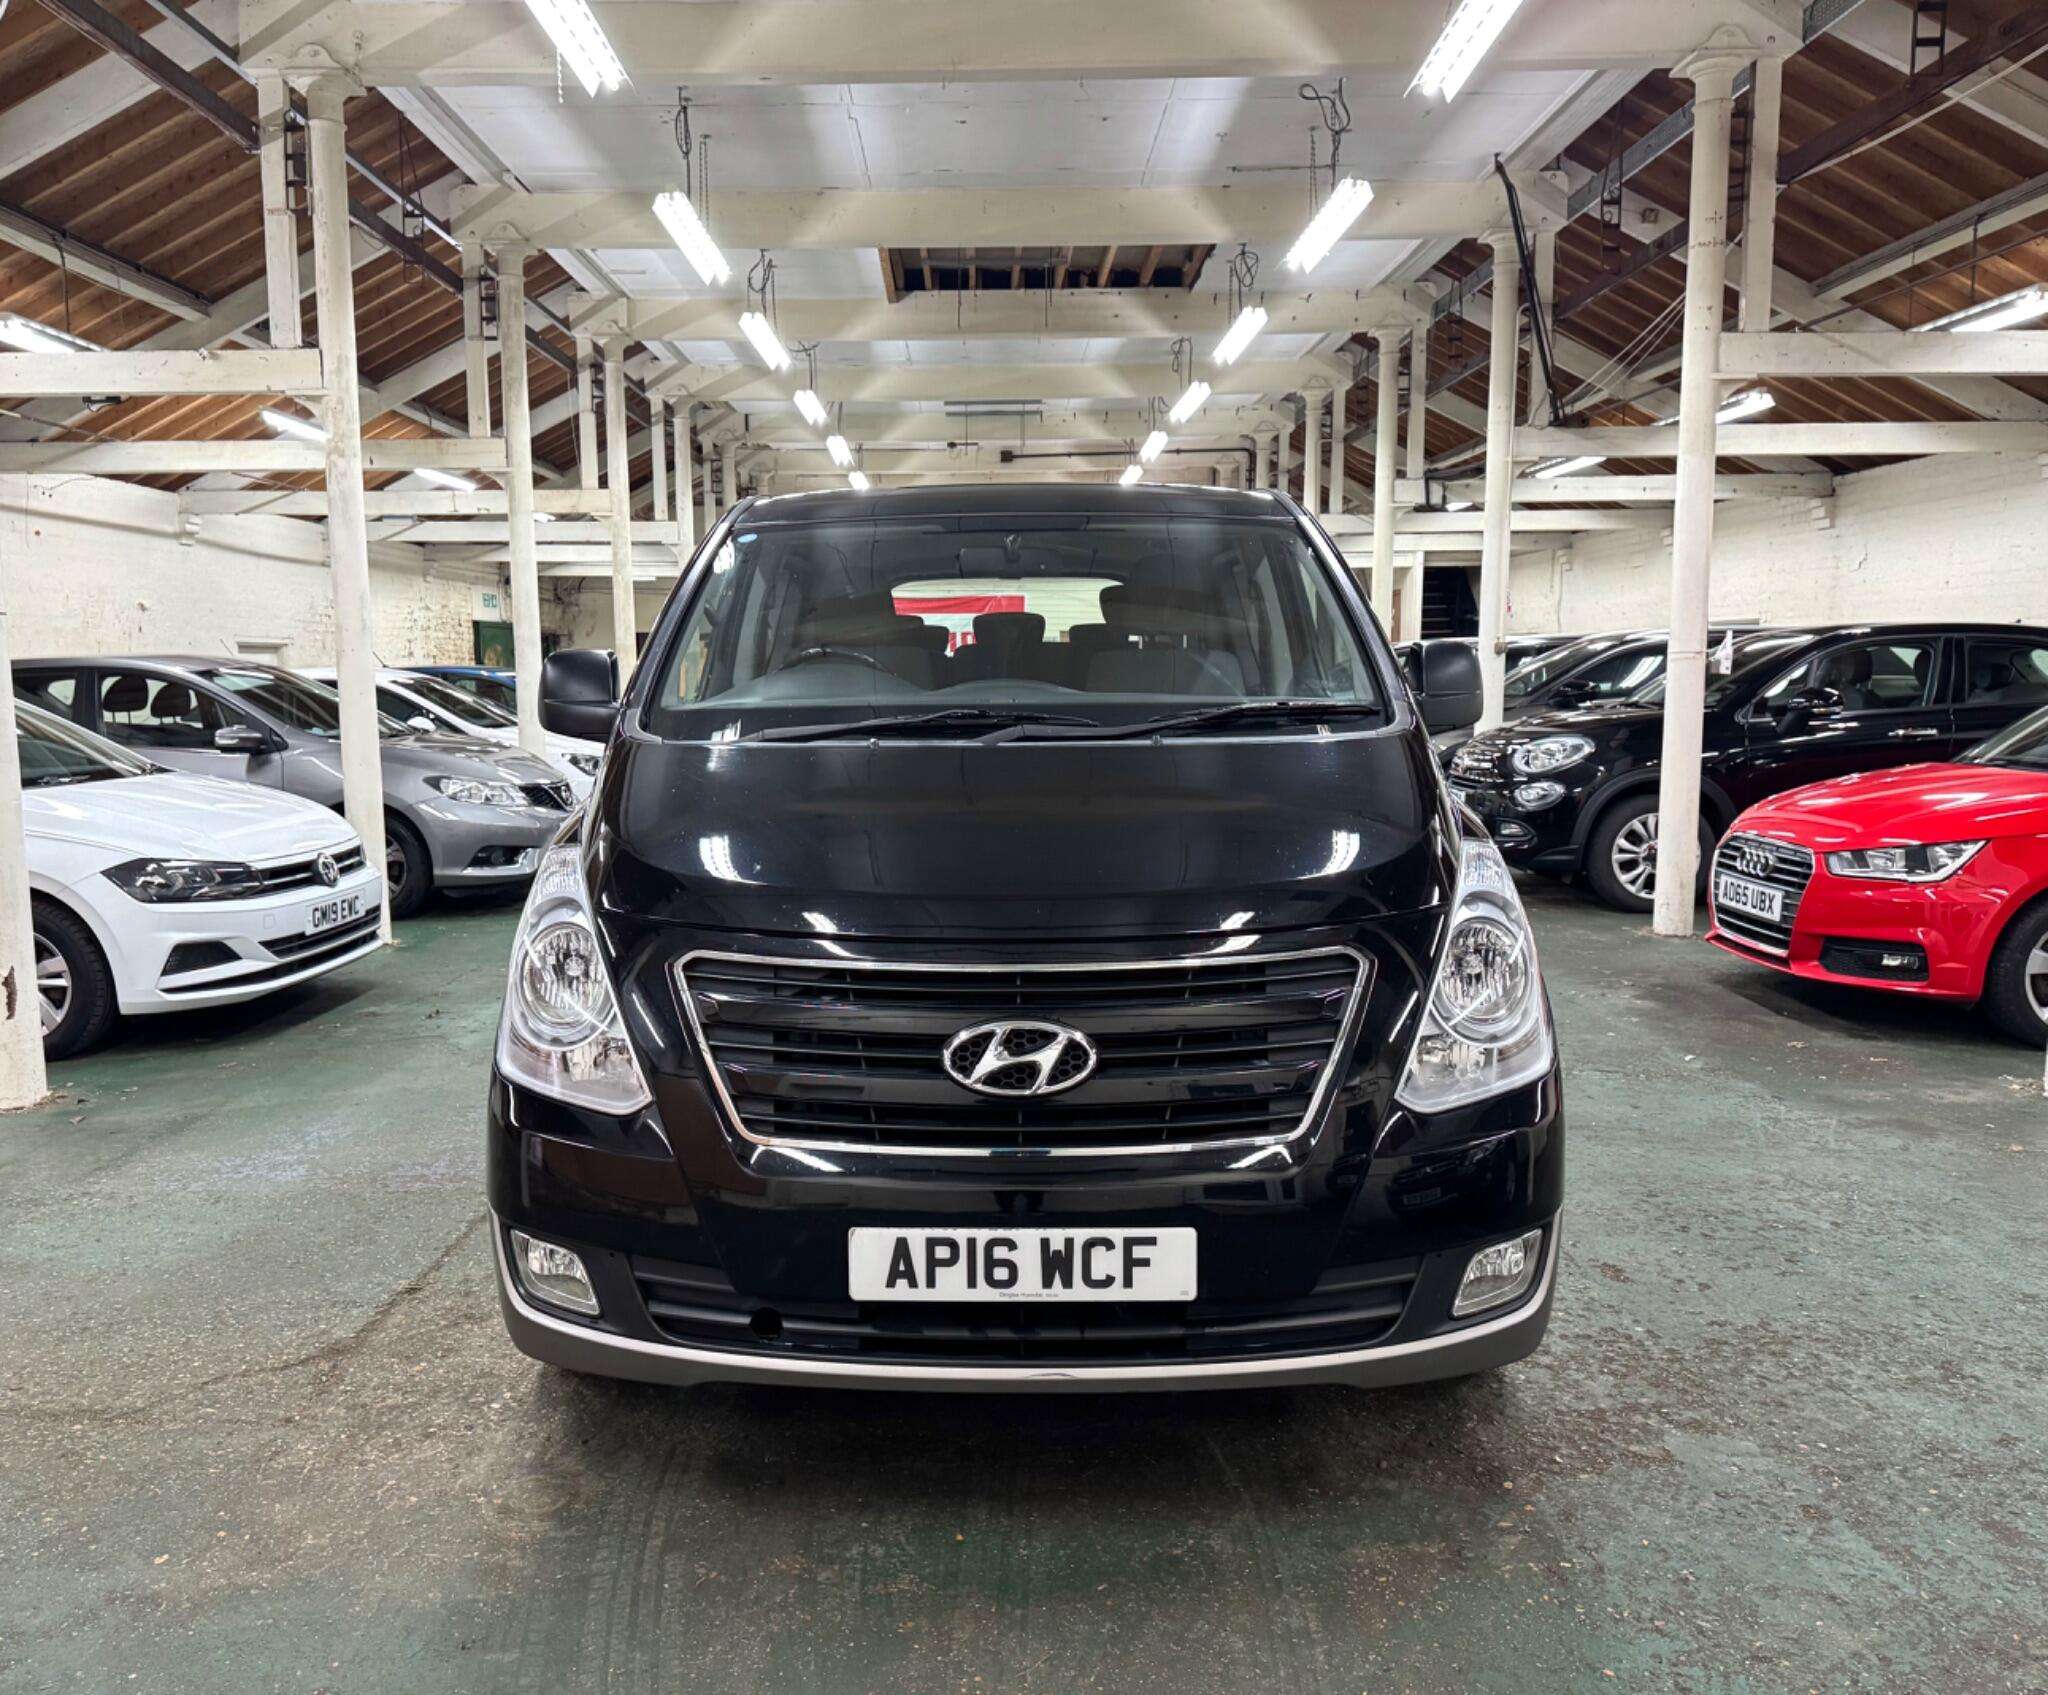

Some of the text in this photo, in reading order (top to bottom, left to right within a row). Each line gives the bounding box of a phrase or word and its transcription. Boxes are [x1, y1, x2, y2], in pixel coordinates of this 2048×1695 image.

[312, 901, 339, 928] GM19
[1751, 888, 1776, 915] UBX
[885, 1236, 1157, 1290] AP16 WCF
